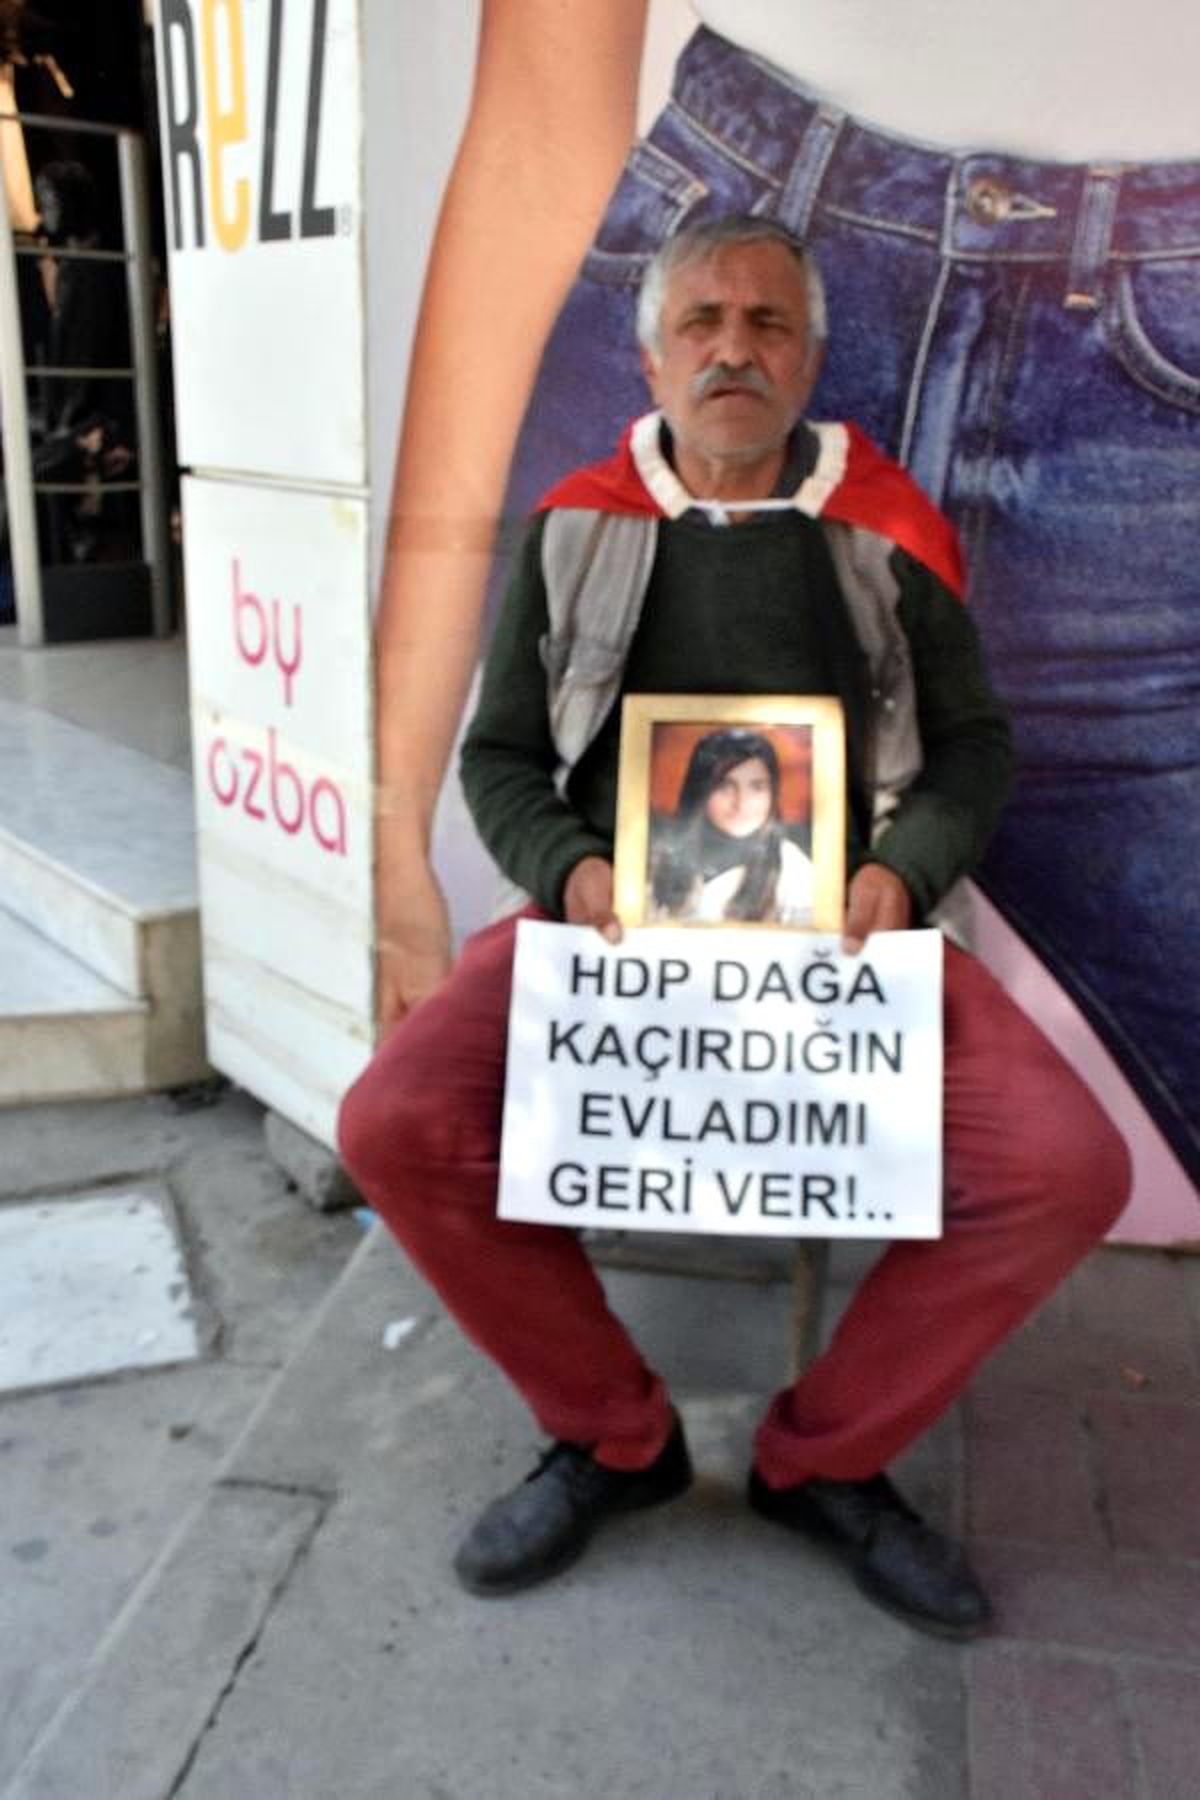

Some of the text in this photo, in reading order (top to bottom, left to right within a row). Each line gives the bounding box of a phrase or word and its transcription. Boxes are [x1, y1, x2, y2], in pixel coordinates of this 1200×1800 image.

[231, 558, 301, 707] by
[571, 950, 887, 1004] HDP DAĞA
[548, 1016, 903, 1082] KAÇIRDIĞIN
[579, 1093, 867, 1146] EVLADIMI
[548, 1157, 894, 1221] GERİ VER!..
